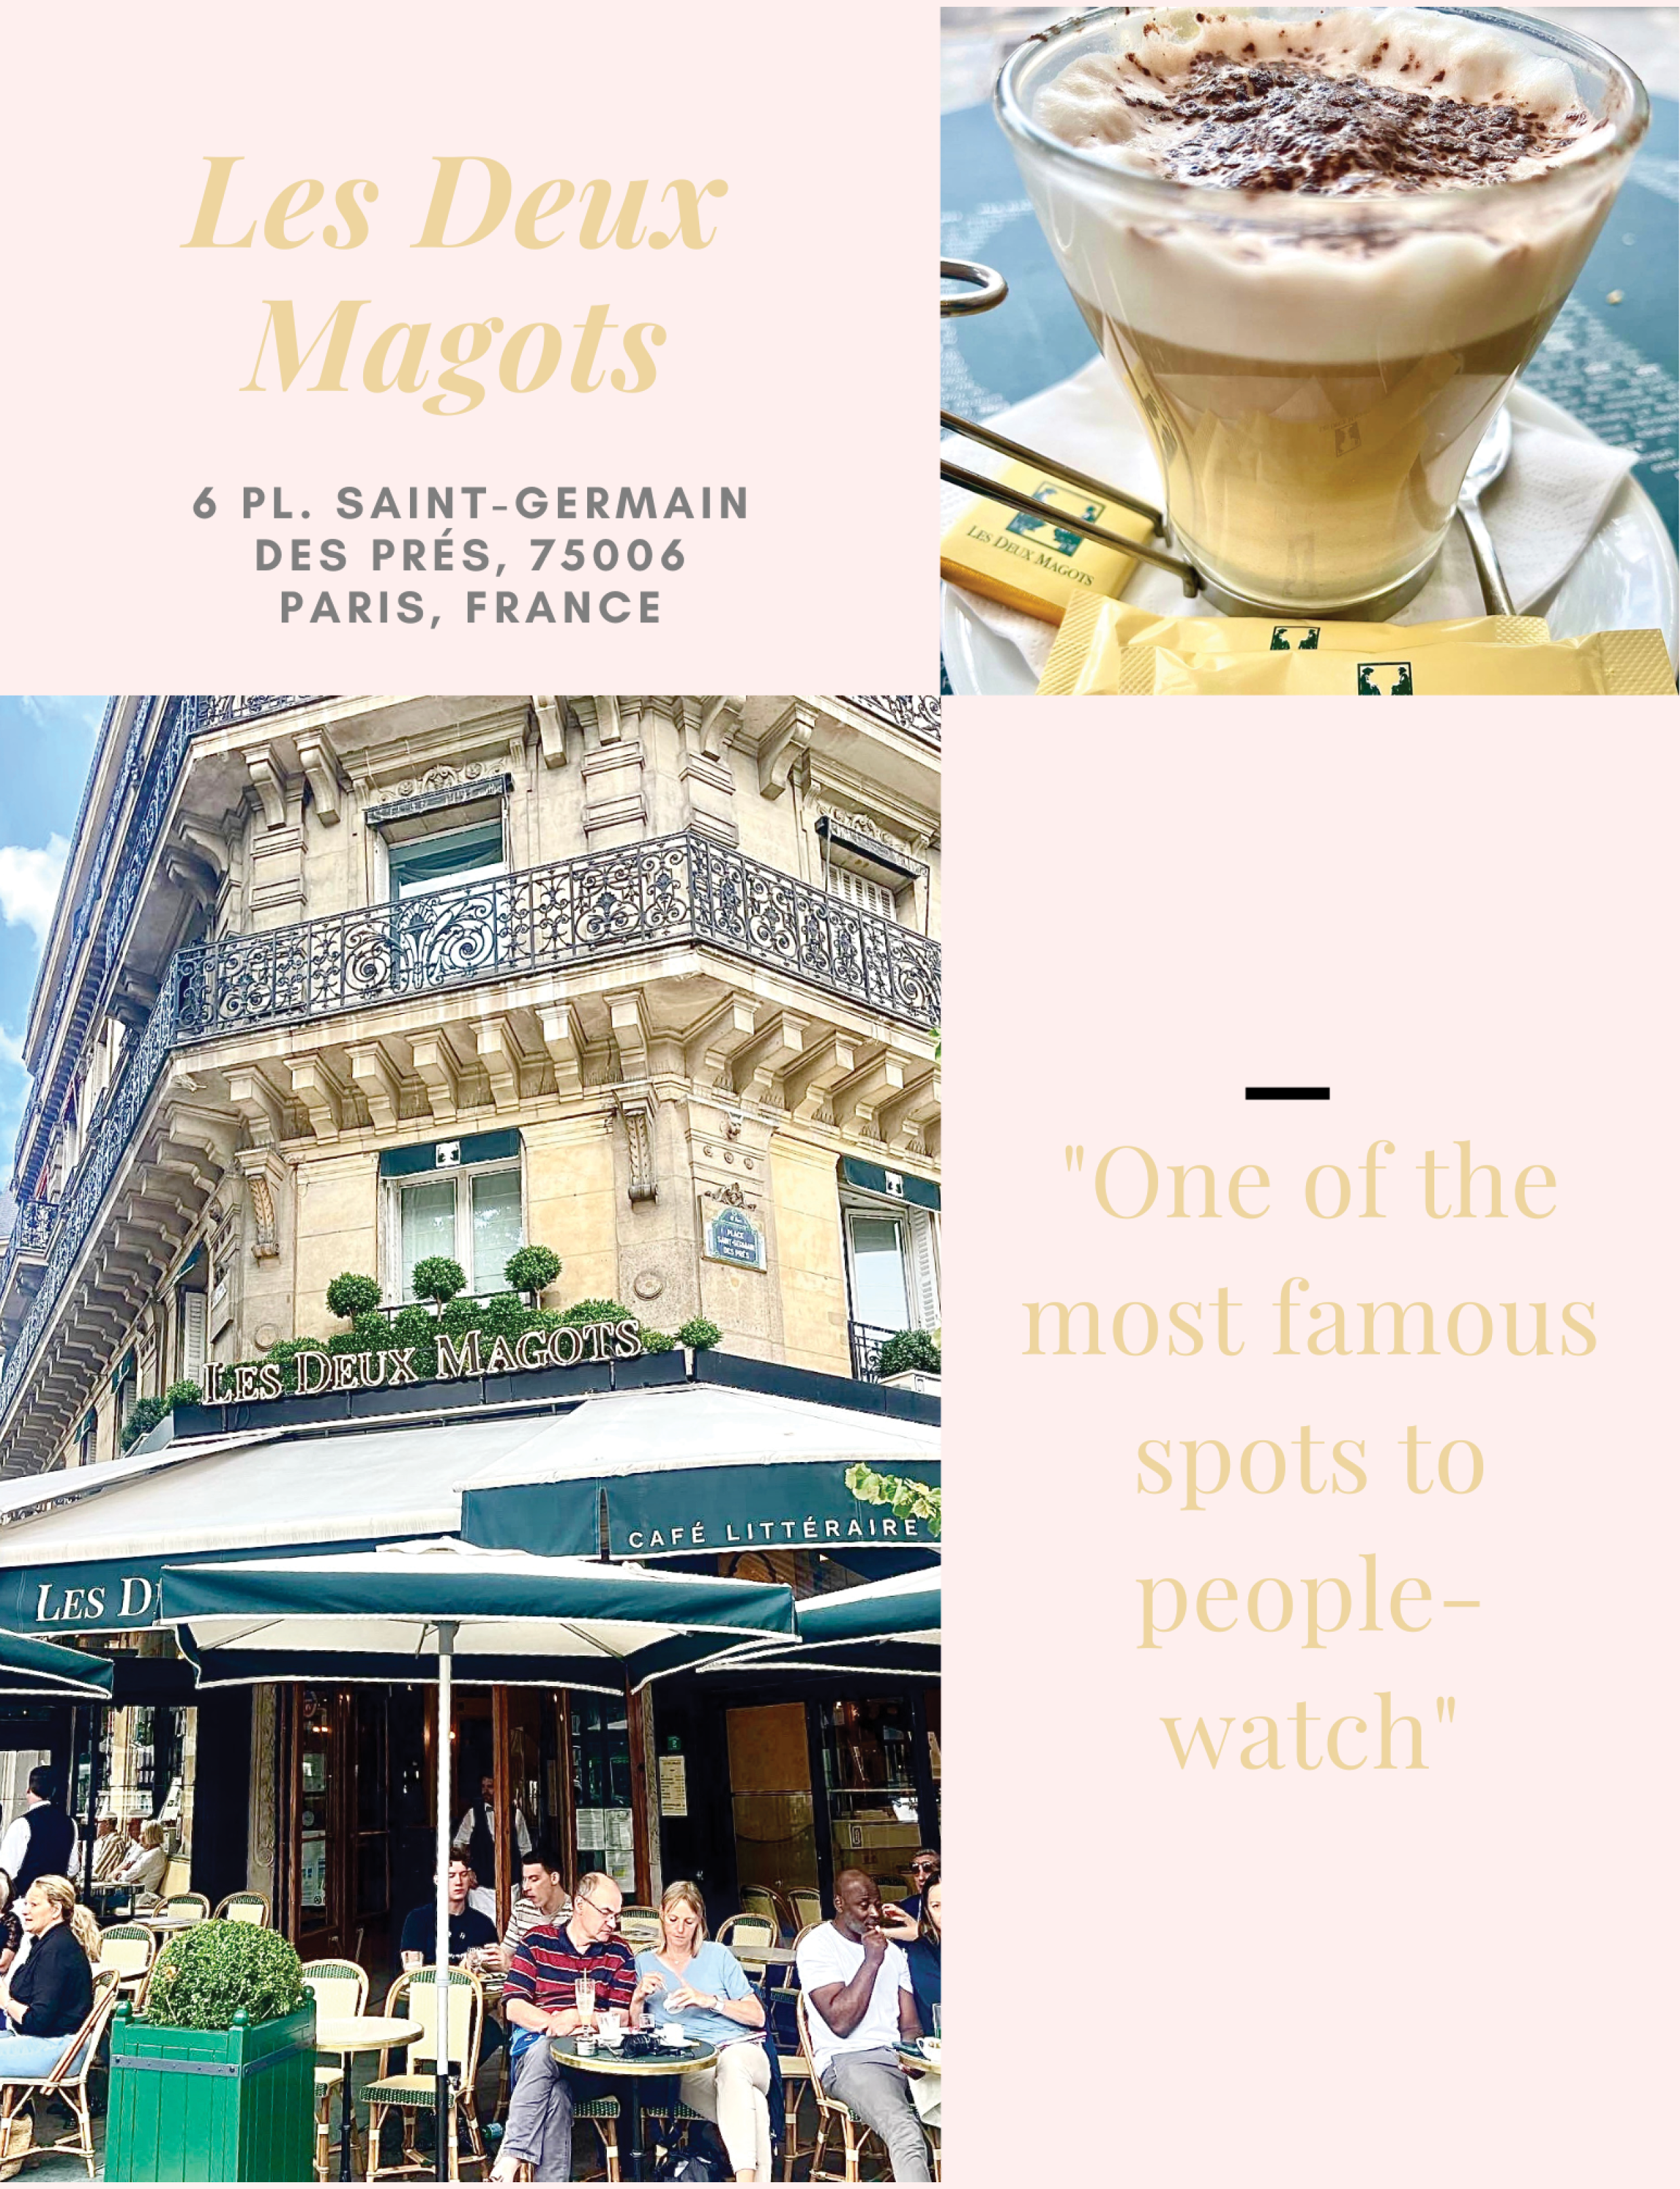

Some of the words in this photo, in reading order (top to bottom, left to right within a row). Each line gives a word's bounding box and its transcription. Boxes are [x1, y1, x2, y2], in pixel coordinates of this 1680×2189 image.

[967, 525, 992, 543] LES
[993, 535, 1035, 561] DEUX
[1034, 553, 1094, 586] MAGOTS
[202, 1361, 283, 1406] LES
[294, 1347, 419, 1395] DEUX
[434, 1320, 642, 1379] MAGOTS
[629, 1521, 706, 1549] CAFÉ
[726, 1516, 918, 1541] LITTÉRAIRE
[36, 1584, 105, 1622] LES
[117, 1577, 162, 1616] D
